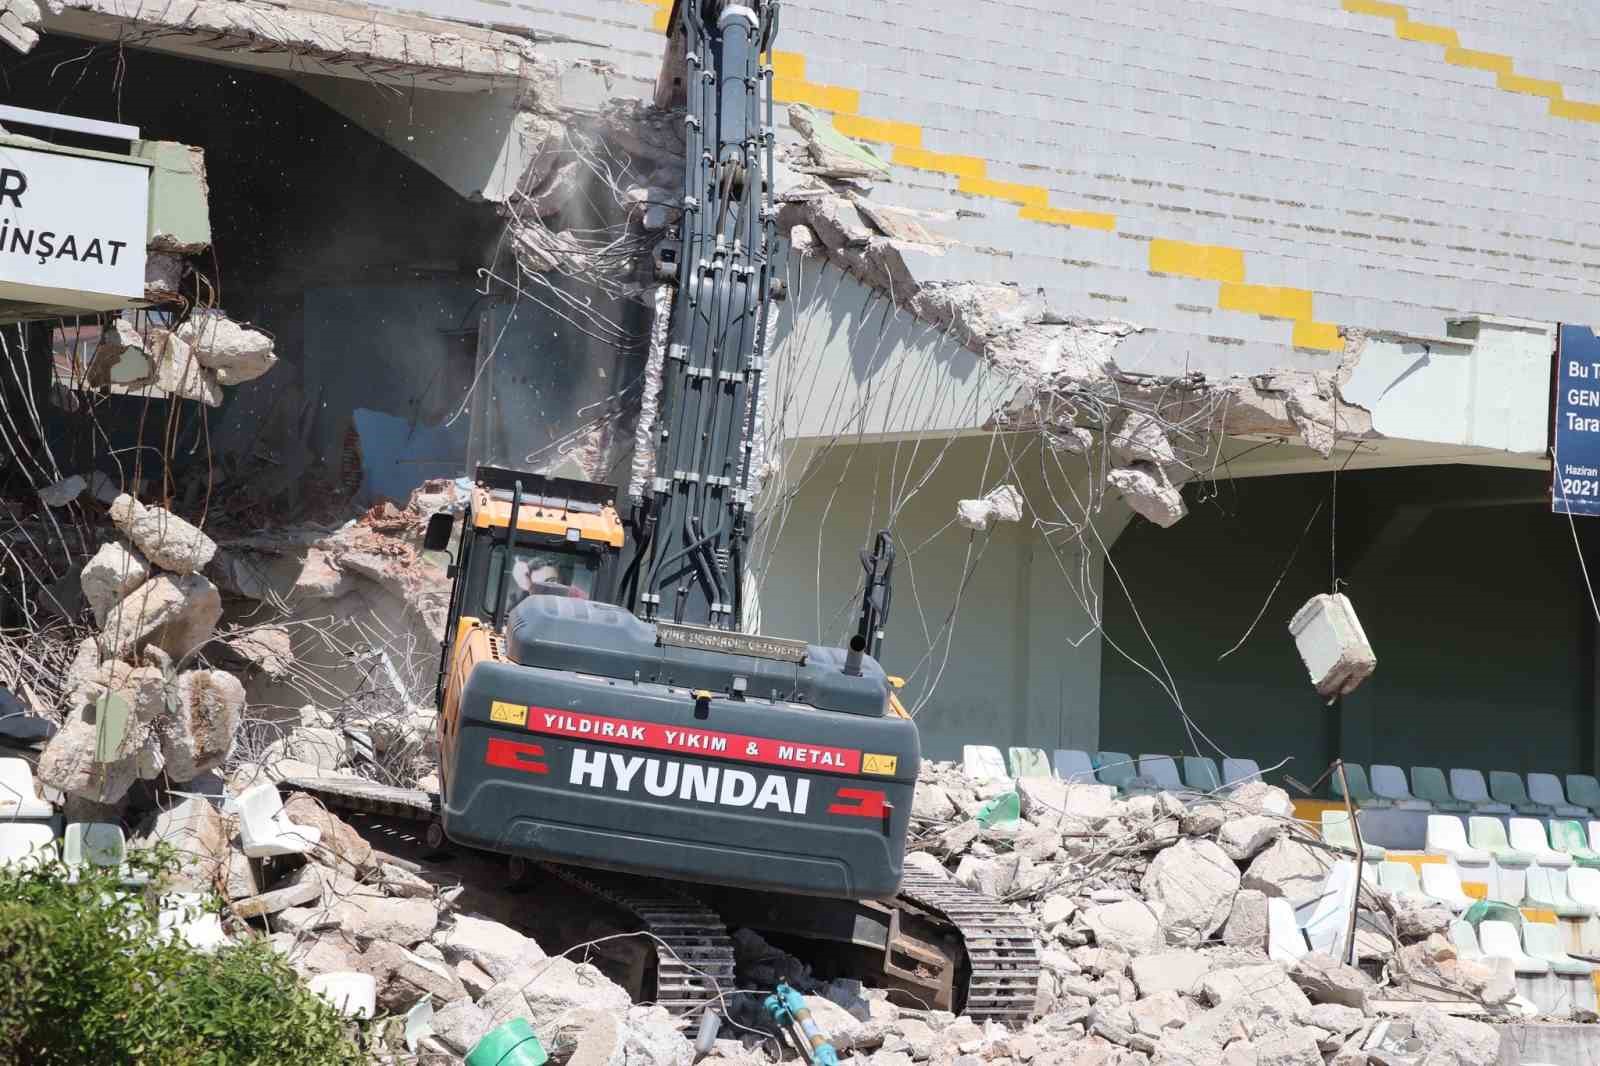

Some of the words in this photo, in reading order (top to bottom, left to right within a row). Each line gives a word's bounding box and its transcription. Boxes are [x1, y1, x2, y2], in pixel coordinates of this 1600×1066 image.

[0, 218, 127, 266] İNŞAAT
[1569, 361, 1589, 378] Bu
[1592, 363, 1600, 379] T
[1568, 389, 1600, 407] GEN
[1565, 464, 1598, 477] Haziran
[1563, 478, 1599, 497] 2021
[544, 713, 646, 741] YILDIRAK
[665, 730, 727, 751] YIKIM
[745, 742, 759, 756] &
[778, 746, 846, 767] METAL
[569, 748, 810, 815] HYUNDAI
